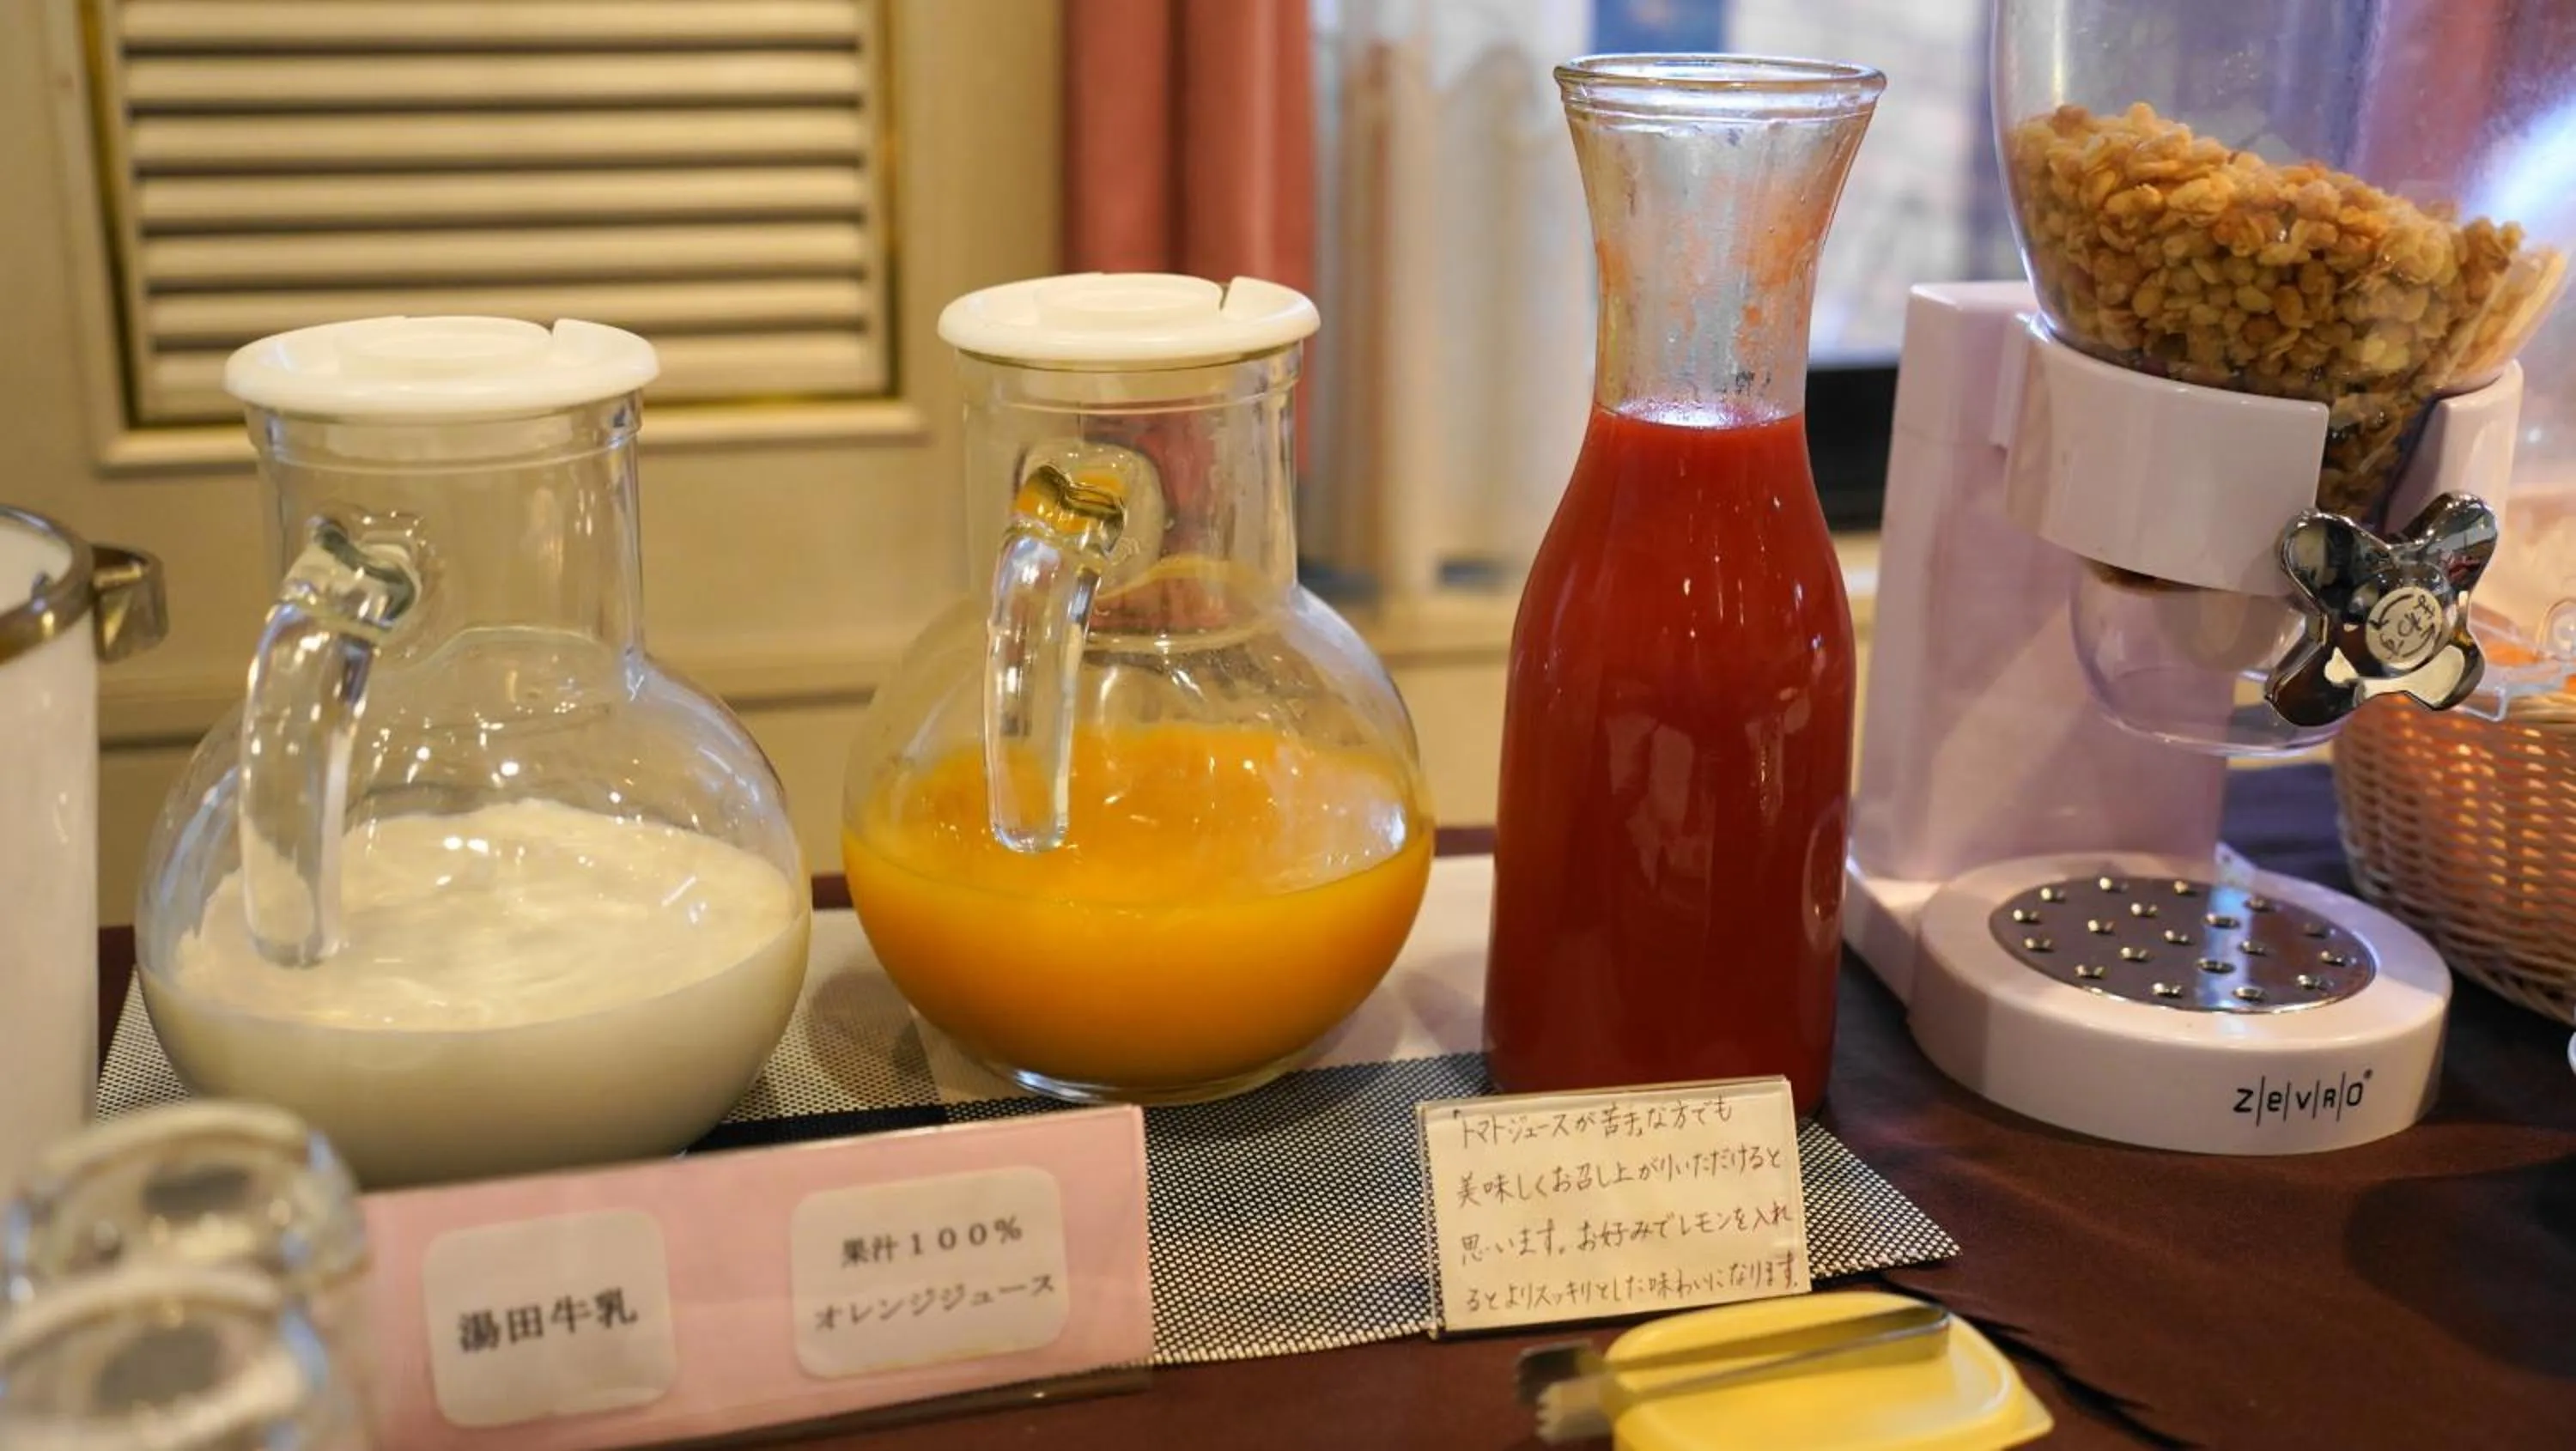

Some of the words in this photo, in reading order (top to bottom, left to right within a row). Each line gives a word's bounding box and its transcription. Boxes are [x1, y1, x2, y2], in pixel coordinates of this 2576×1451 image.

[1457, 1144, 1780, 1208] 美味しくお召し上がりいただけると
[459, 1288, 638, 1351] 湯田牛乳
[814, 1274, 1054, 1330] オレンジジュース
